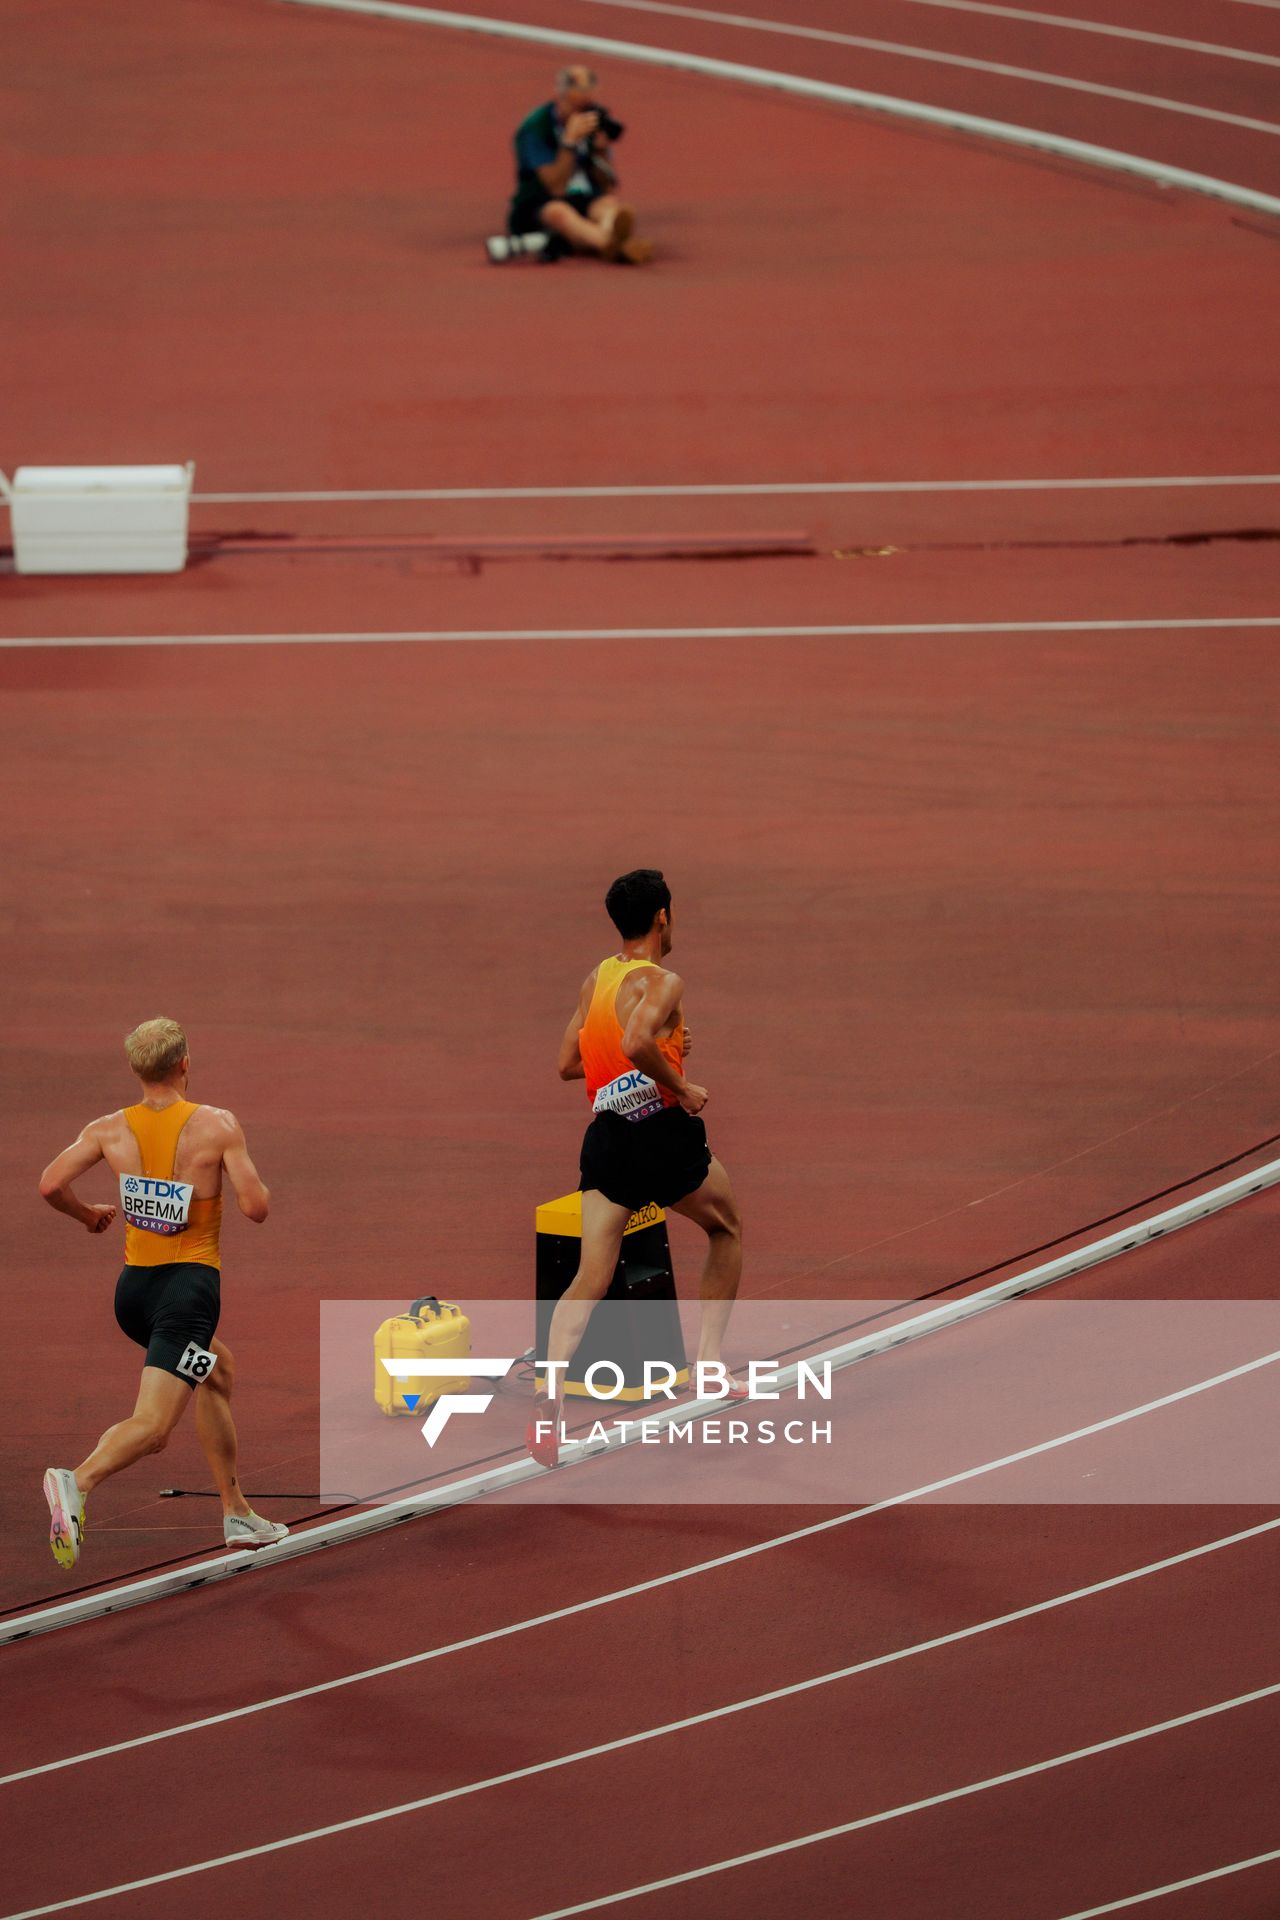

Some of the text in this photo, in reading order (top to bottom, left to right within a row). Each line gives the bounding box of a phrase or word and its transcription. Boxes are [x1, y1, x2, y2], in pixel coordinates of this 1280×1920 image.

[609, 1072, 649, 1096] TDK
[138, 1179, 187, 1202] TDK
[124, 1196, 184, 1222] BREMM
[135, 1219, 170, 1232] TOKYO
[183, 1348, 212, 1377] 18
